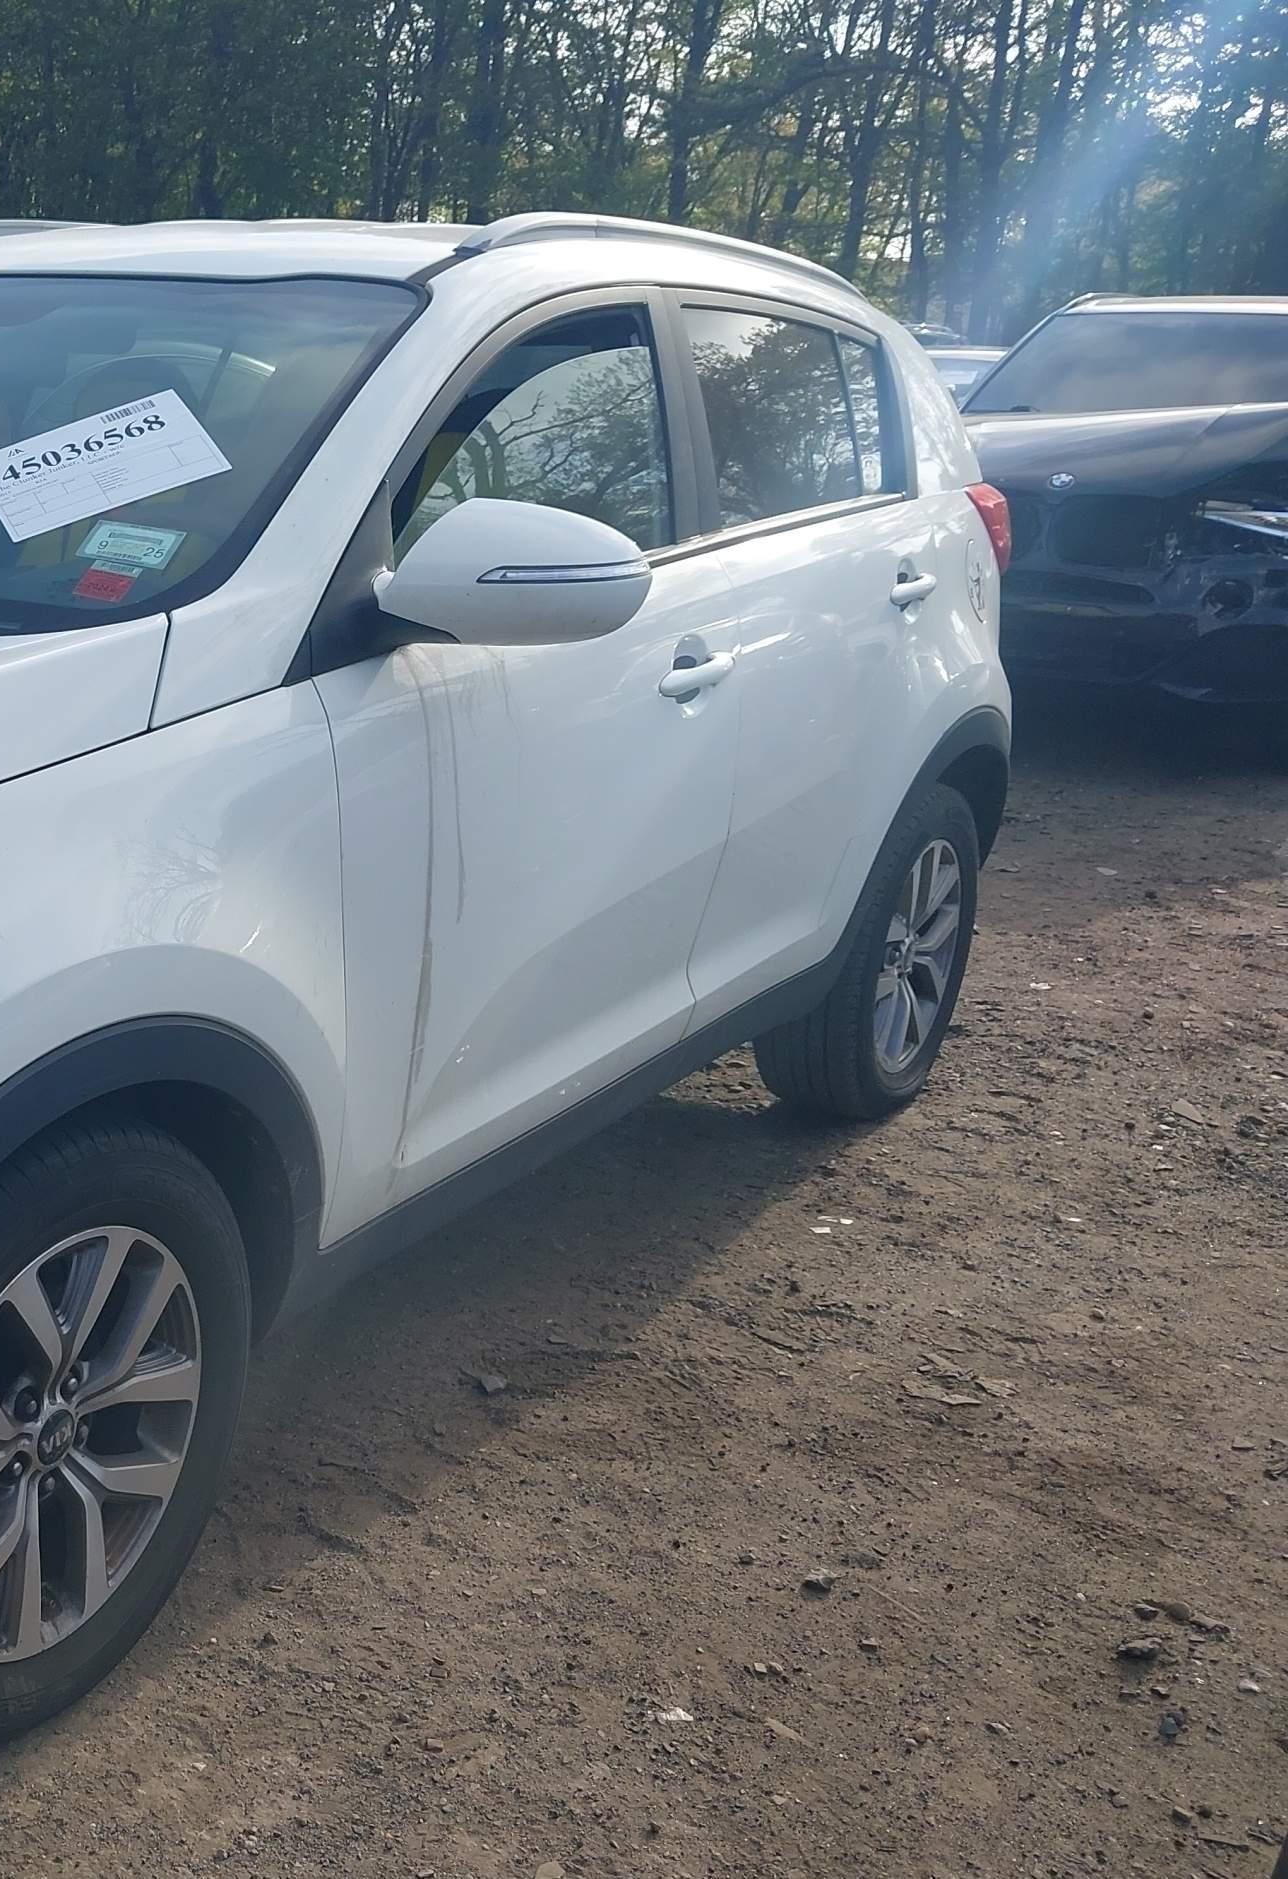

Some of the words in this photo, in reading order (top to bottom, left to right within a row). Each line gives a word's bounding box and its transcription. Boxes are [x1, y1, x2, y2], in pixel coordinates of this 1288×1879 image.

[2, 414, 166, 481] 45036568
[97, 540, 109, 550] 9
[143, 547, 165, 559] 25
